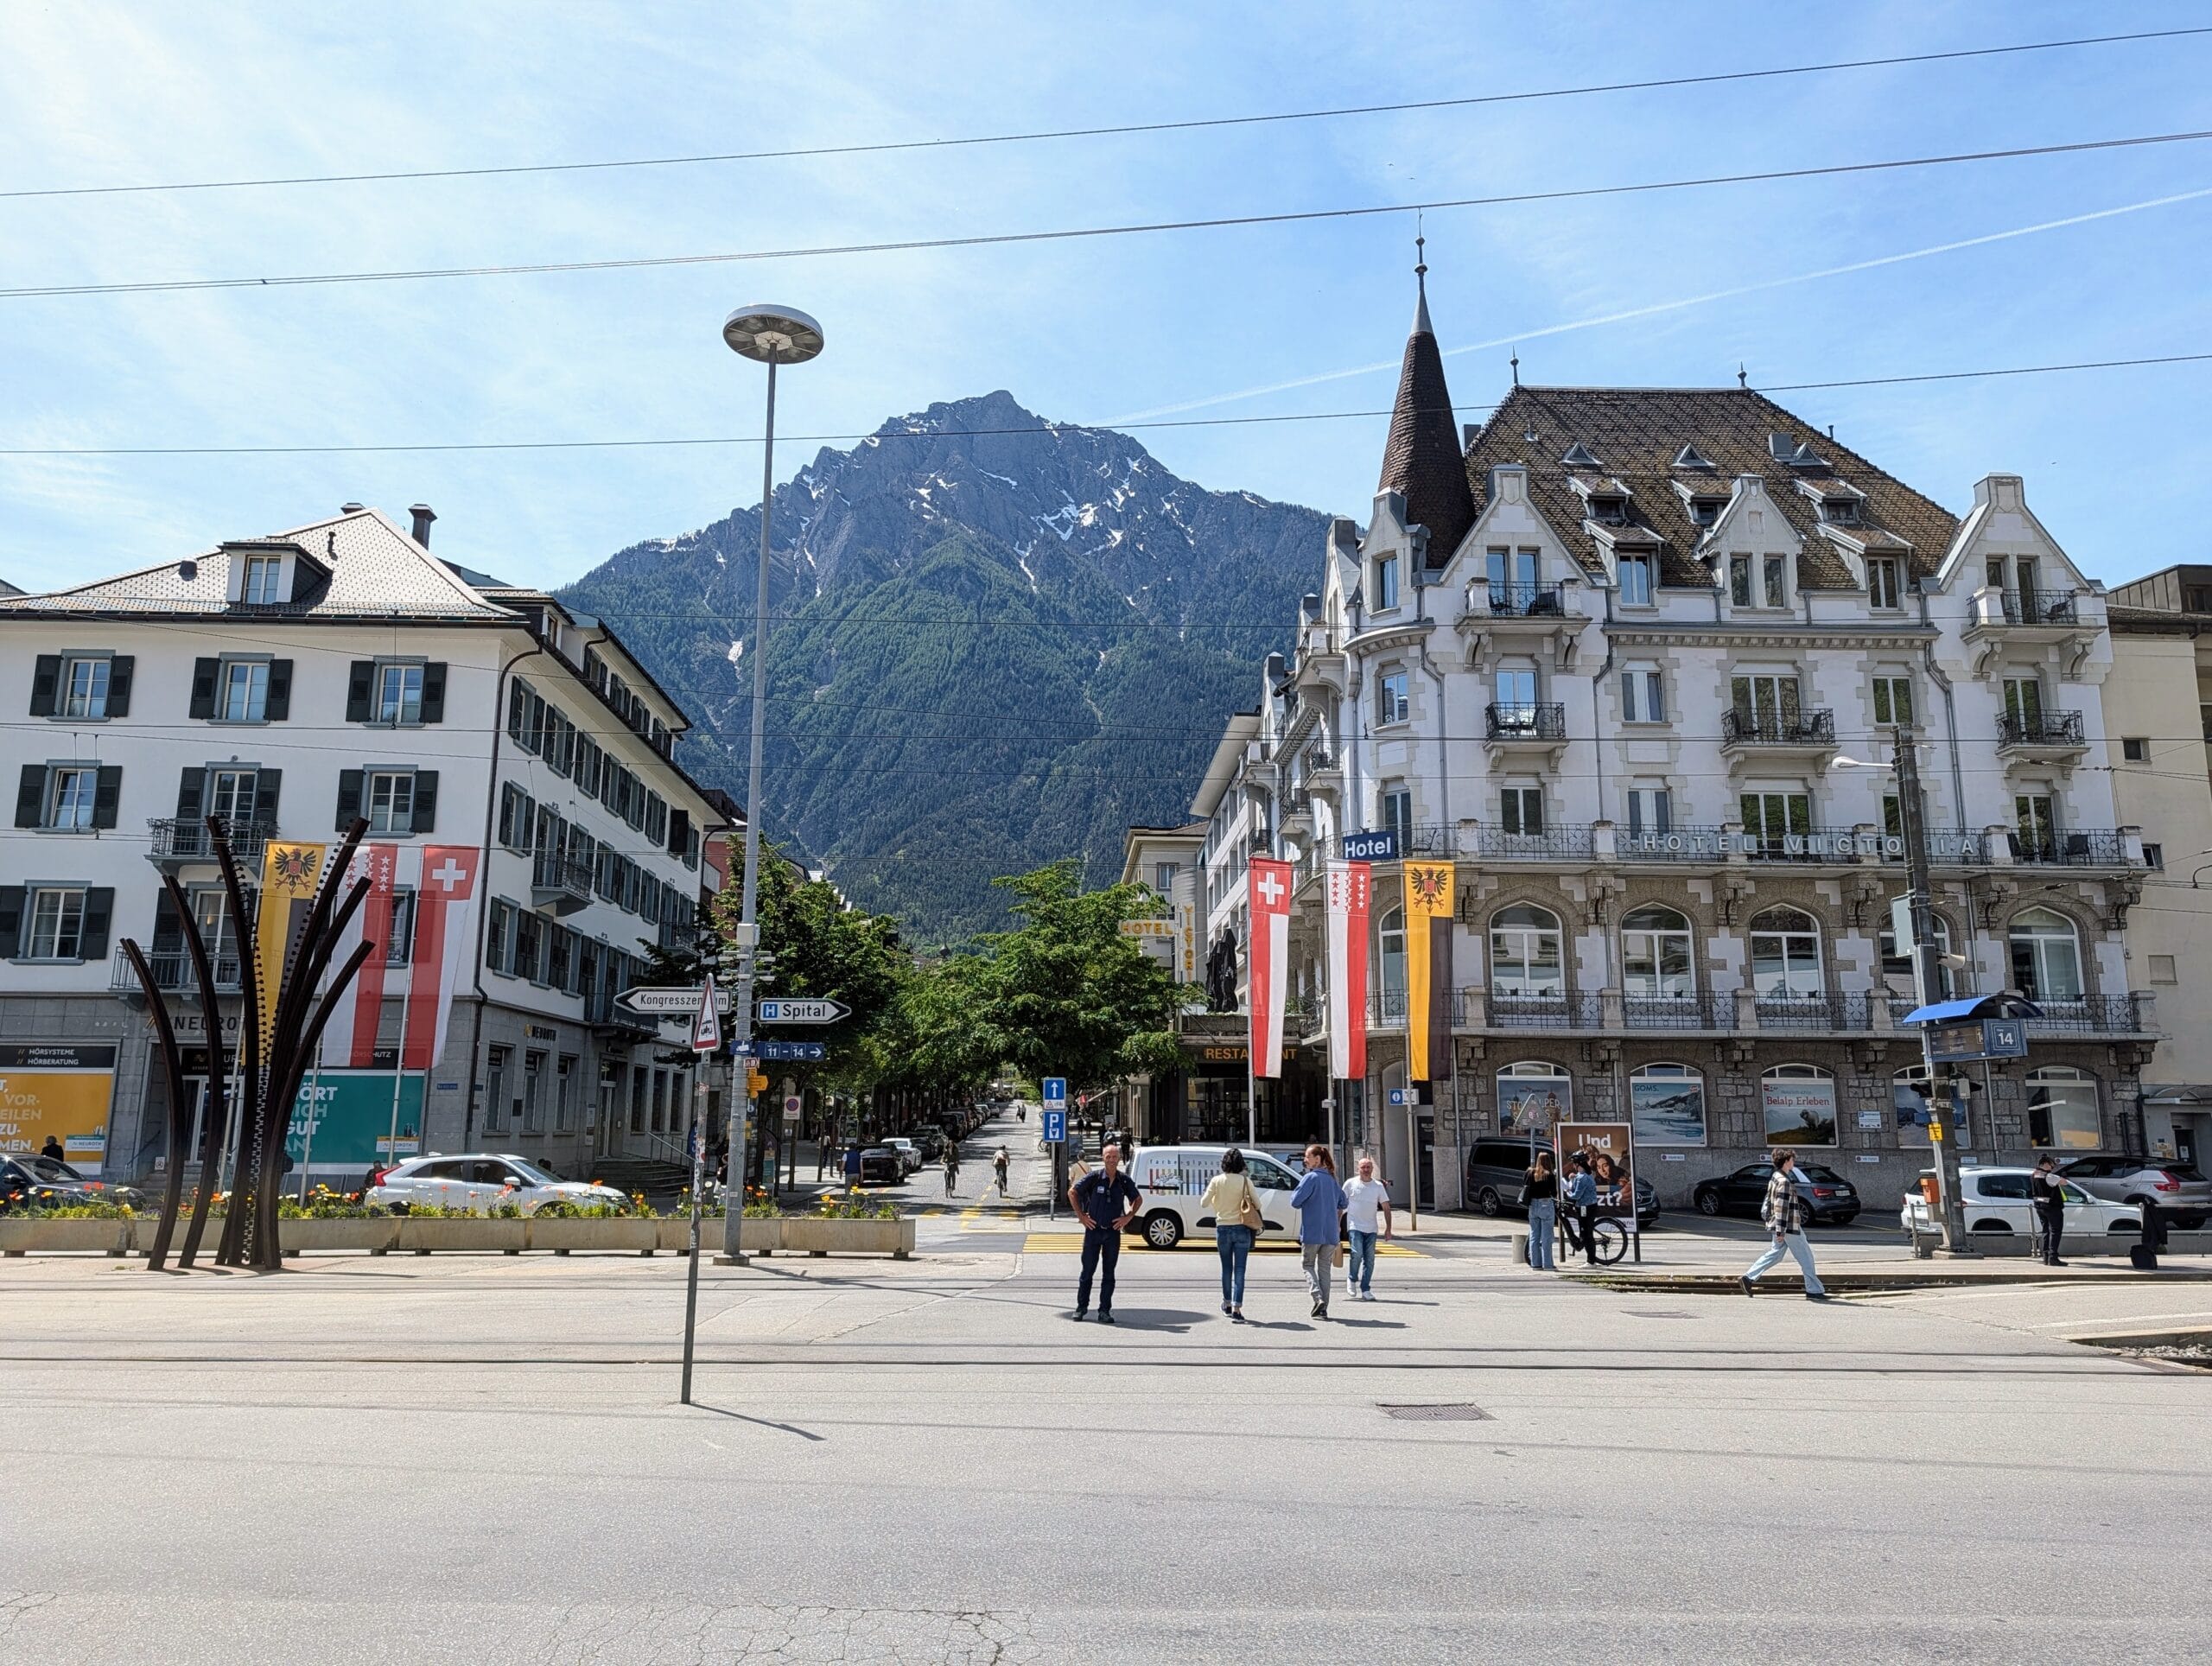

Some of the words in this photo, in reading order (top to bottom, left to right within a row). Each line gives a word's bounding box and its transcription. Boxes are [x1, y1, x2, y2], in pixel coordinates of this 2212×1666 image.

[1344, 836, 1391, 858] Hotel
[1643, 835, 1753, 851] HOTEL
[1788, 836, 1974, 854] VICTOIA
[1122, 921, 1174, 935] HOTEL
[1184, 906, 1195, 982] VICTORI
[640, 994, 727, 1007] Kongresszenm
[783, 1003, 826, 1020] Spital
[1998, 1032, 2014, 1046] 14
[767, 1047, 777, 1056] 11
[793, 1048, 804, 1058] 14
[1205, 1047, 1297, 1059] RESTANT
[296, 1082, 338, 1101] ÖRT
[5, 1094, 41, 1107] VOR-
[1766, 1096, 1793, 1107] Belalp
[1796, 1096, 1830, 1106] Erleben
[294, 1103, 327, 1117] ICH
[1050, 1114, 1059, 1128] P
[1579, 1134, 1611, 1148] Und
